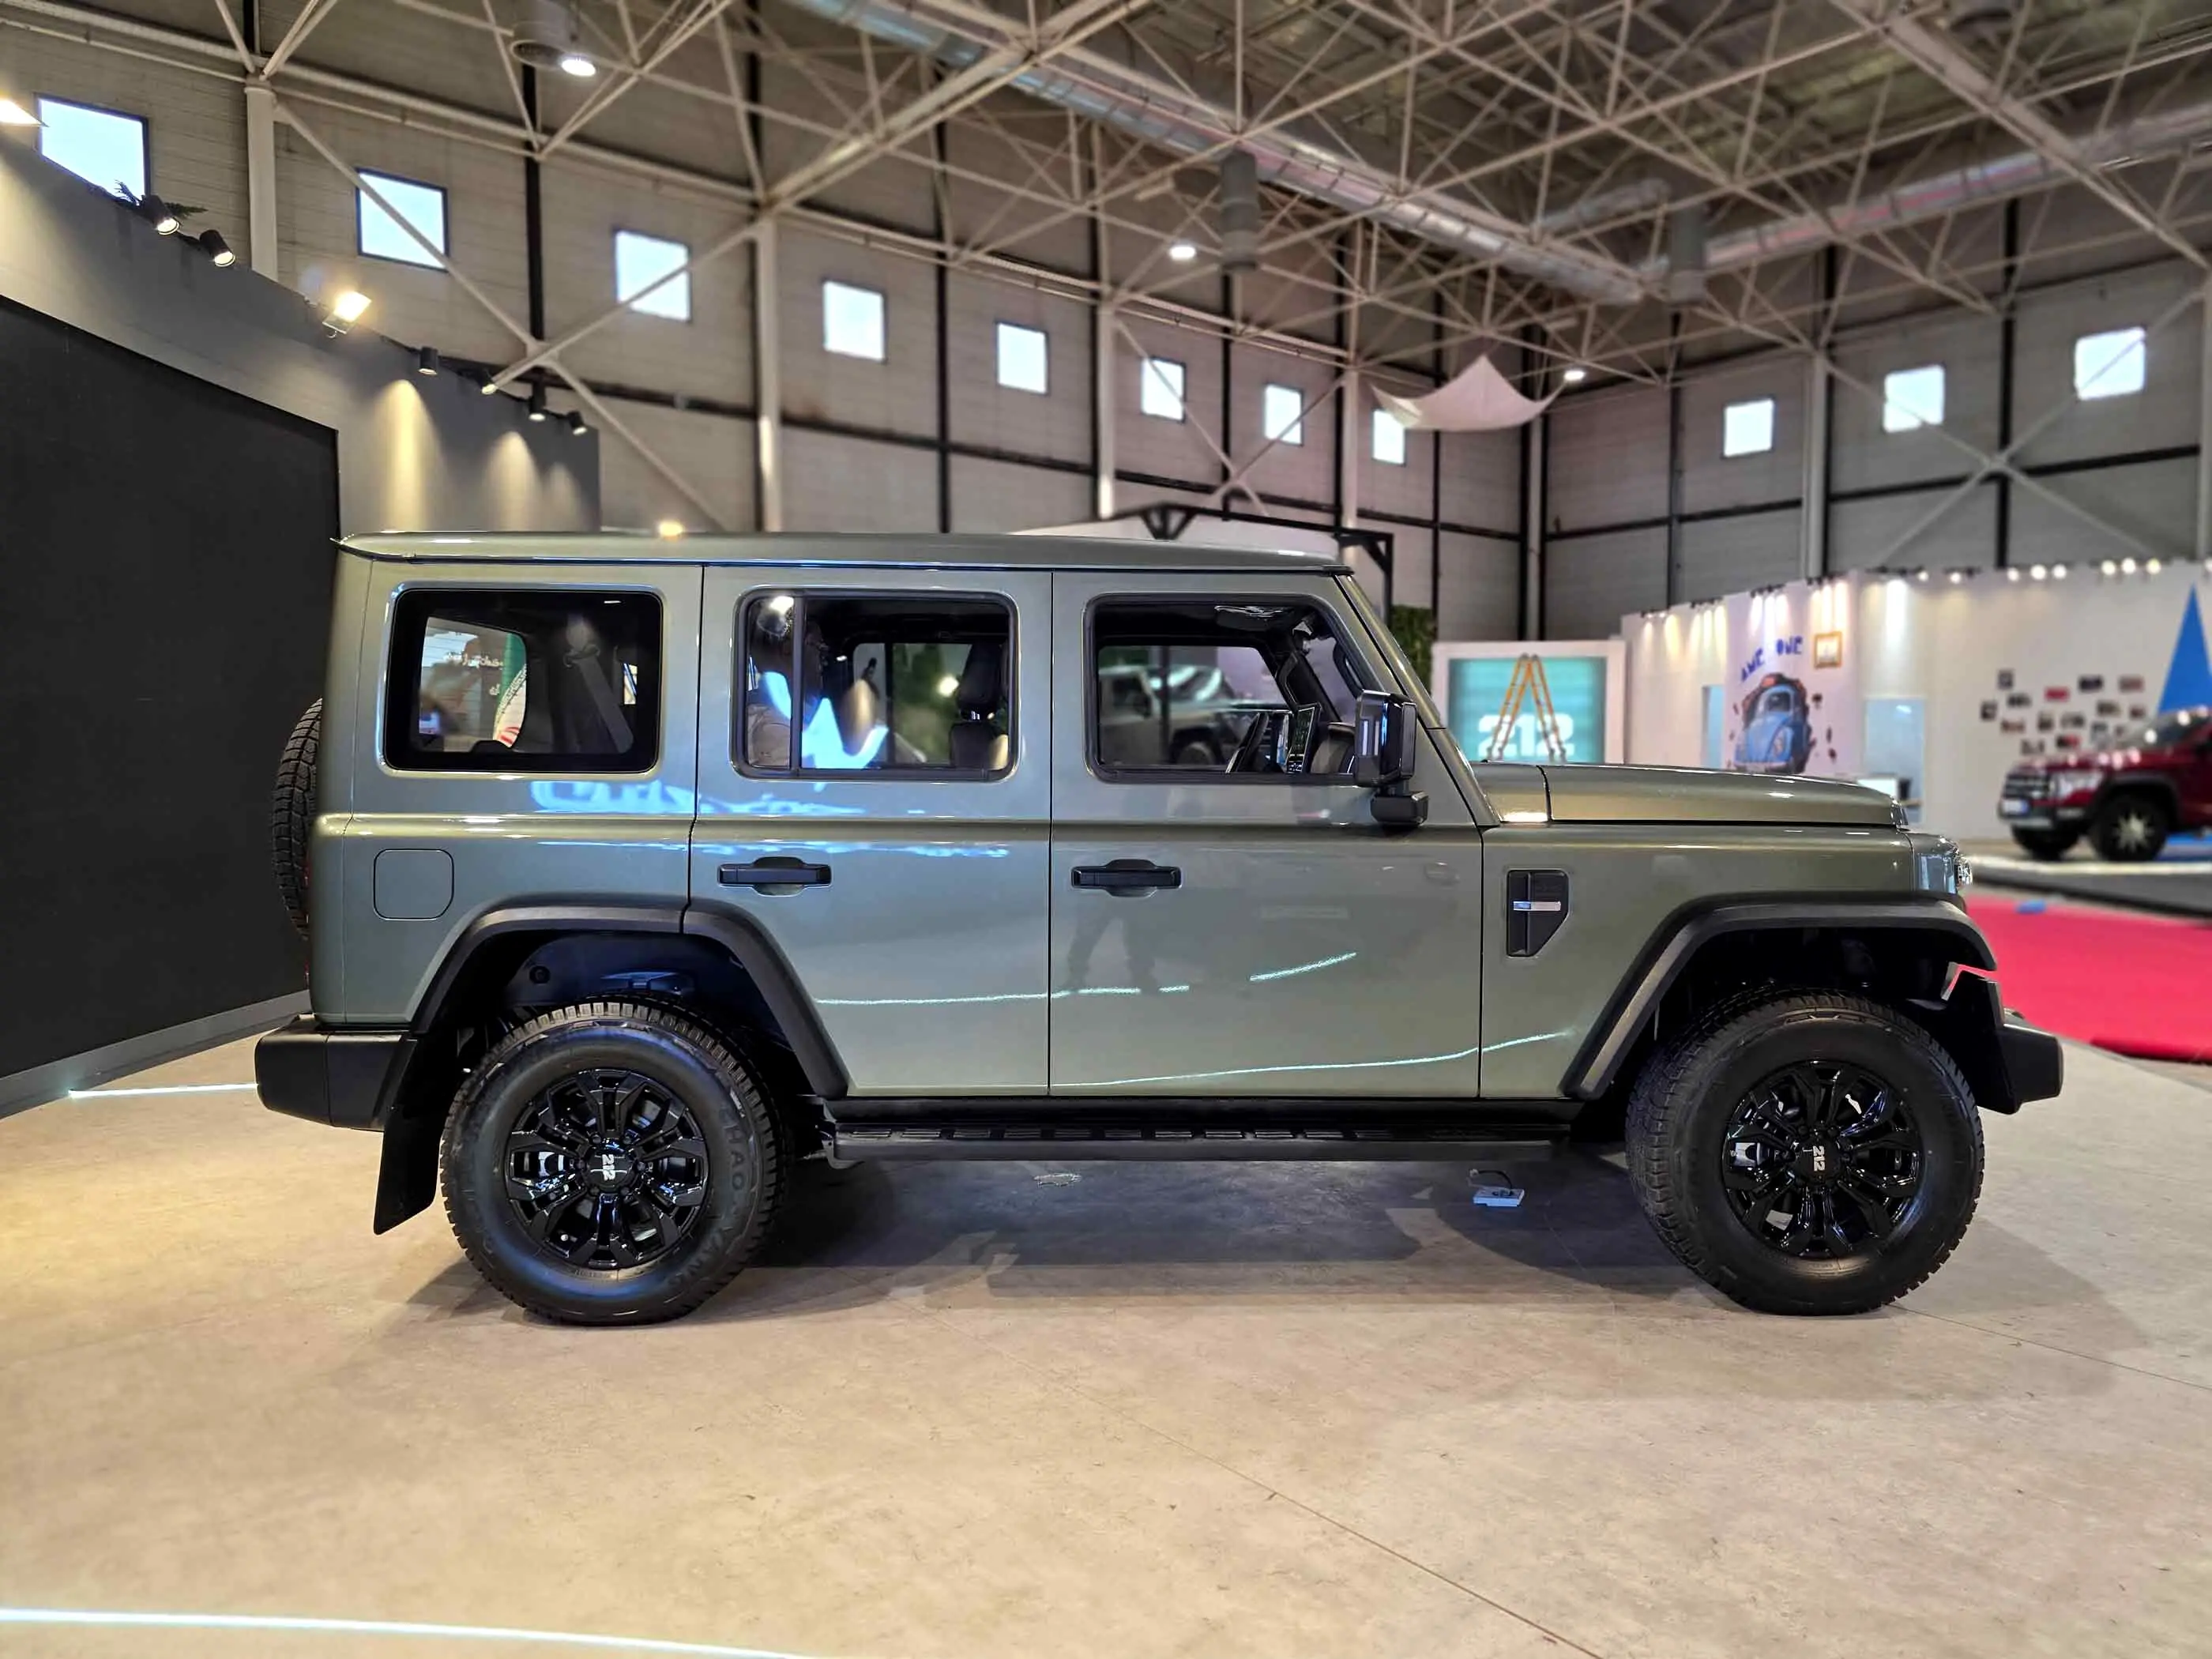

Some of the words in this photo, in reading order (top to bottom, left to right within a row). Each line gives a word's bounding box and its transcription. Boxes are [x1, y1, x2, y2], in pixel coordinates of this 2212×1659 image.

[1478, 713, 1574, 758] 212
[602, 1154, 615, 1181] 212
[1813, 1146, 1825, 1172] 212
